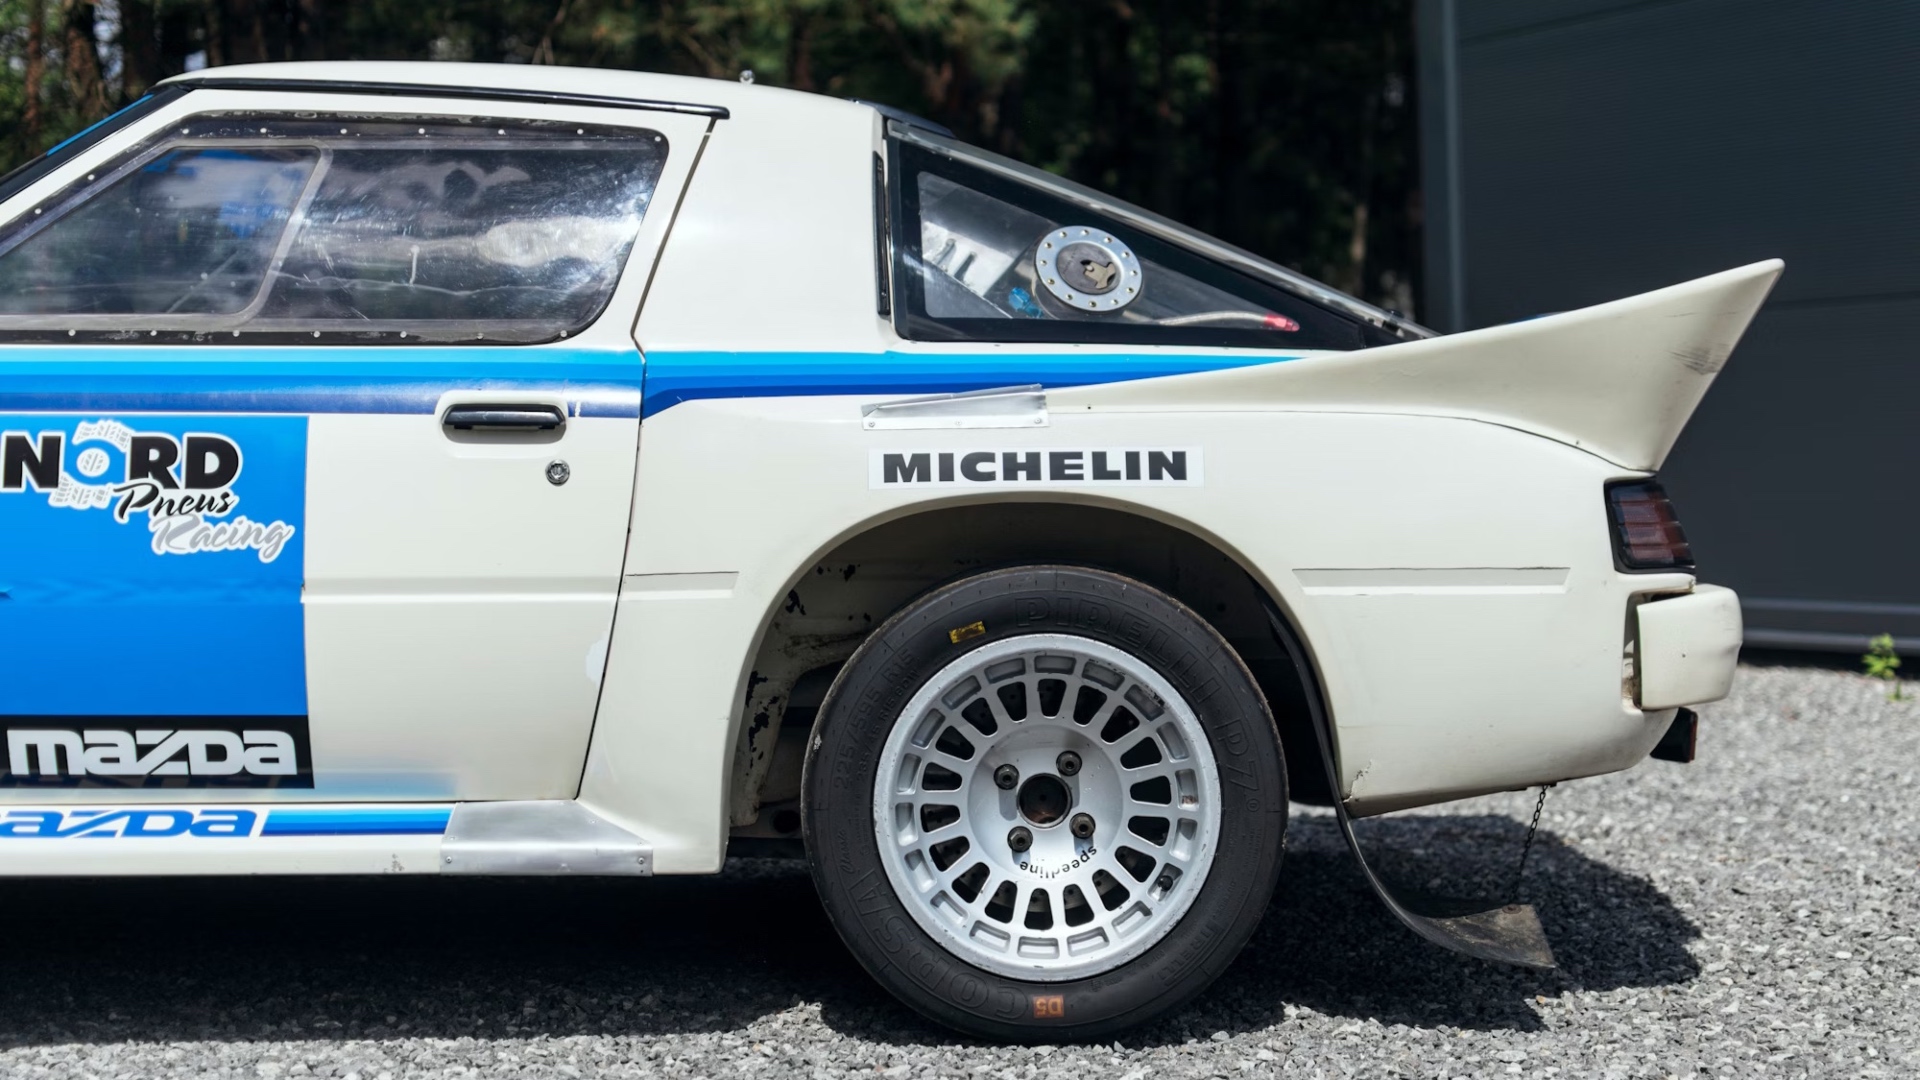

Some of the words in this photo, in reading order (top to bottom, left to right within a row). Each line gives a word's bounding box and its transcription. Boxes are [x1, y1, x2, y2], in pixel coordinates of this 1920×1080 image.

[3, 434, 240, 489] NORD
[883, 451, 1187, 483] MICHELIN
[114, 482, 234, 519] Pneus
[152, 513, 289, 557] Racing
[1014, 596, 1220, 705] PIRELLI
[7, 729, 297, 776] mazda
[0, 810, 257, 838] azda
[848, 868, 1029, 1020] CORSA
[1036, 997, 1062, 1016] D5
